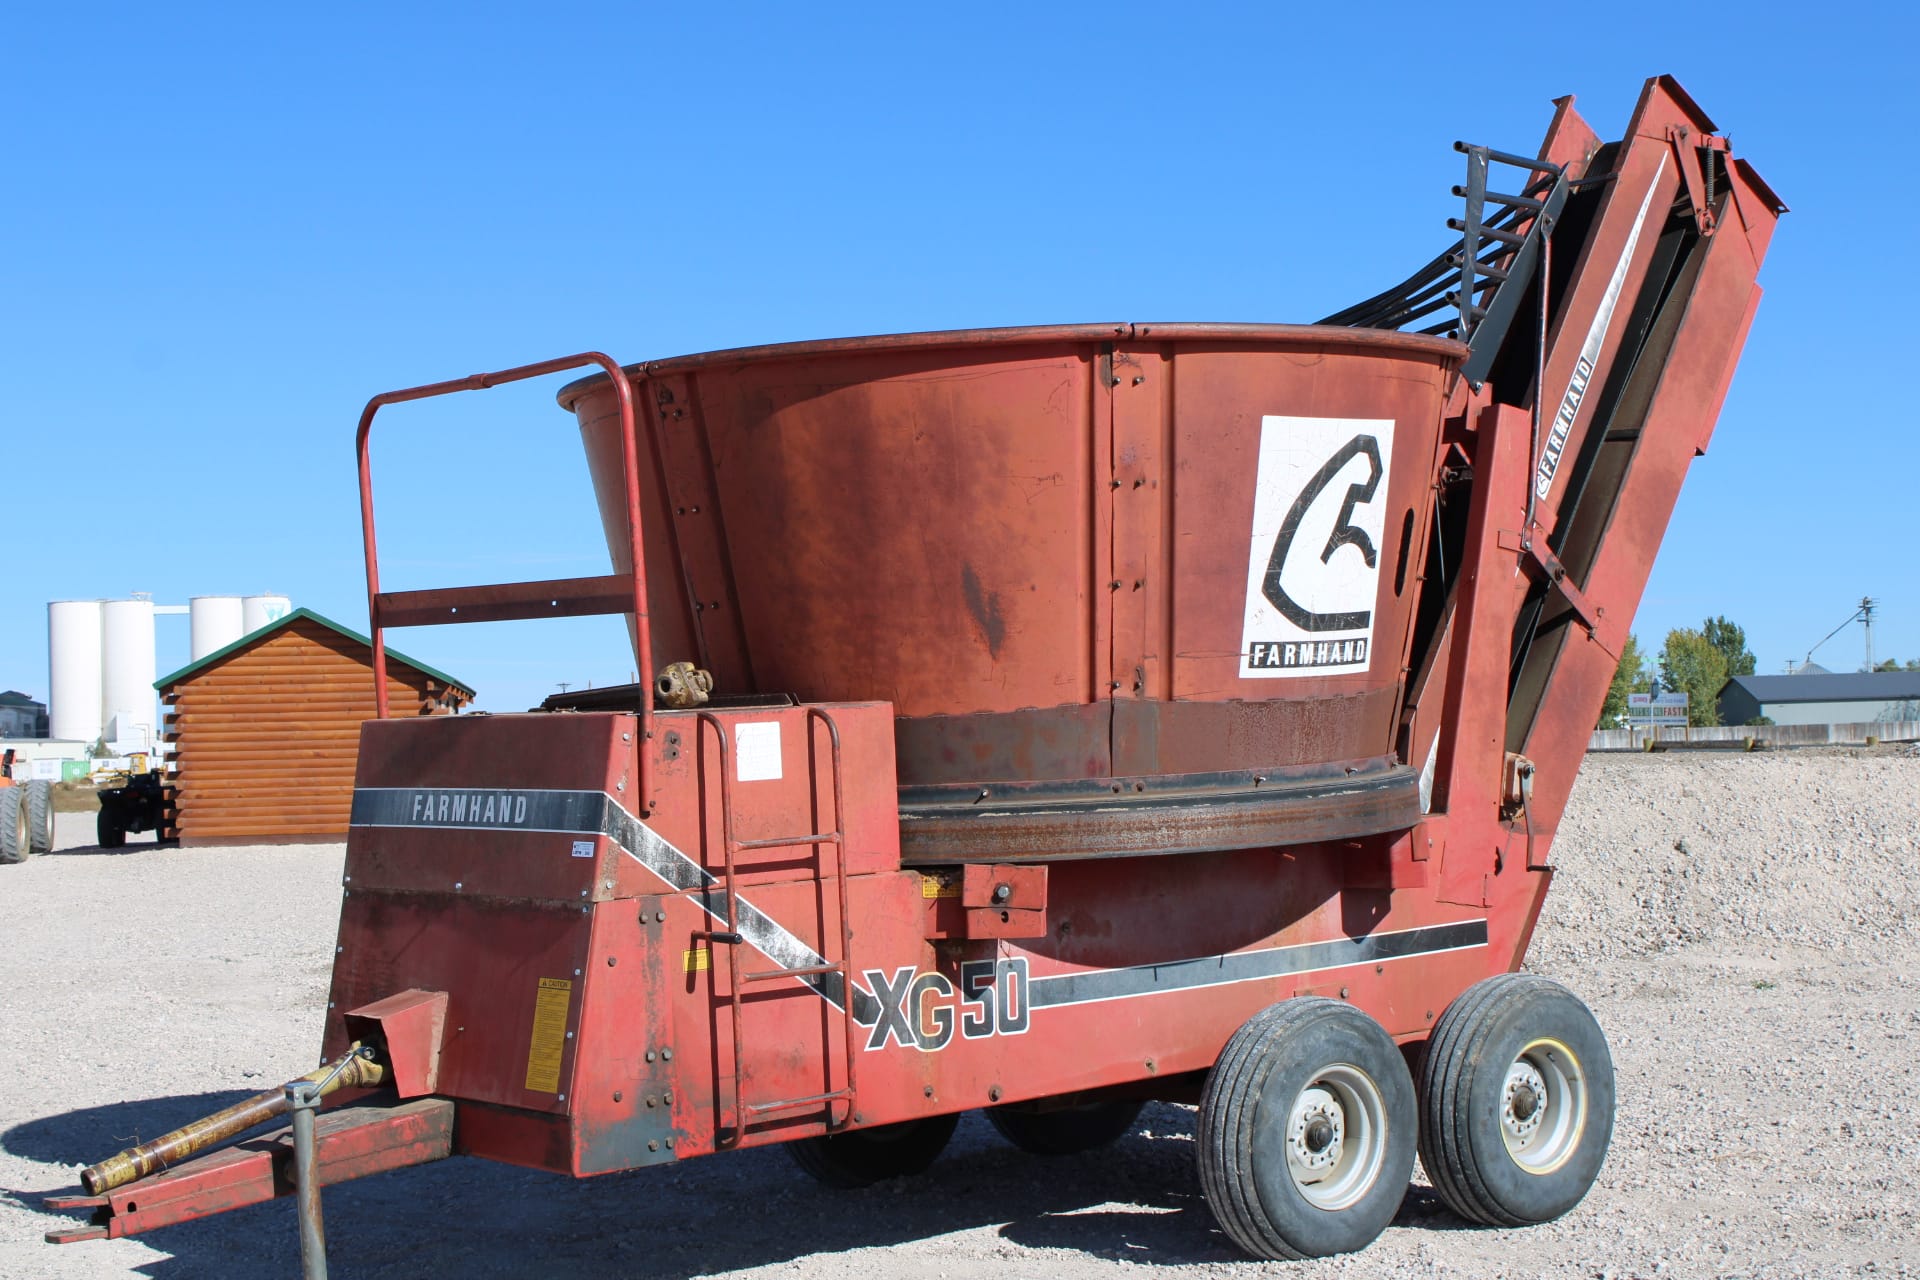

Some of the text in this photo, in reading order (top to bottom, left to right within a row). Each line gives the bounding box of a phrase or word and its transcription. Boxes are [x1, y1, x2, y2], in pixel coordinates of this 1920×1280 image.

[1541, 360, 1591, 476] FARMHAND
[1253, 639, 1365, 666] FARMHAND
[1663, 707, 1681, 716] FAST
[412, 794, 527, 824] FARMHAND
